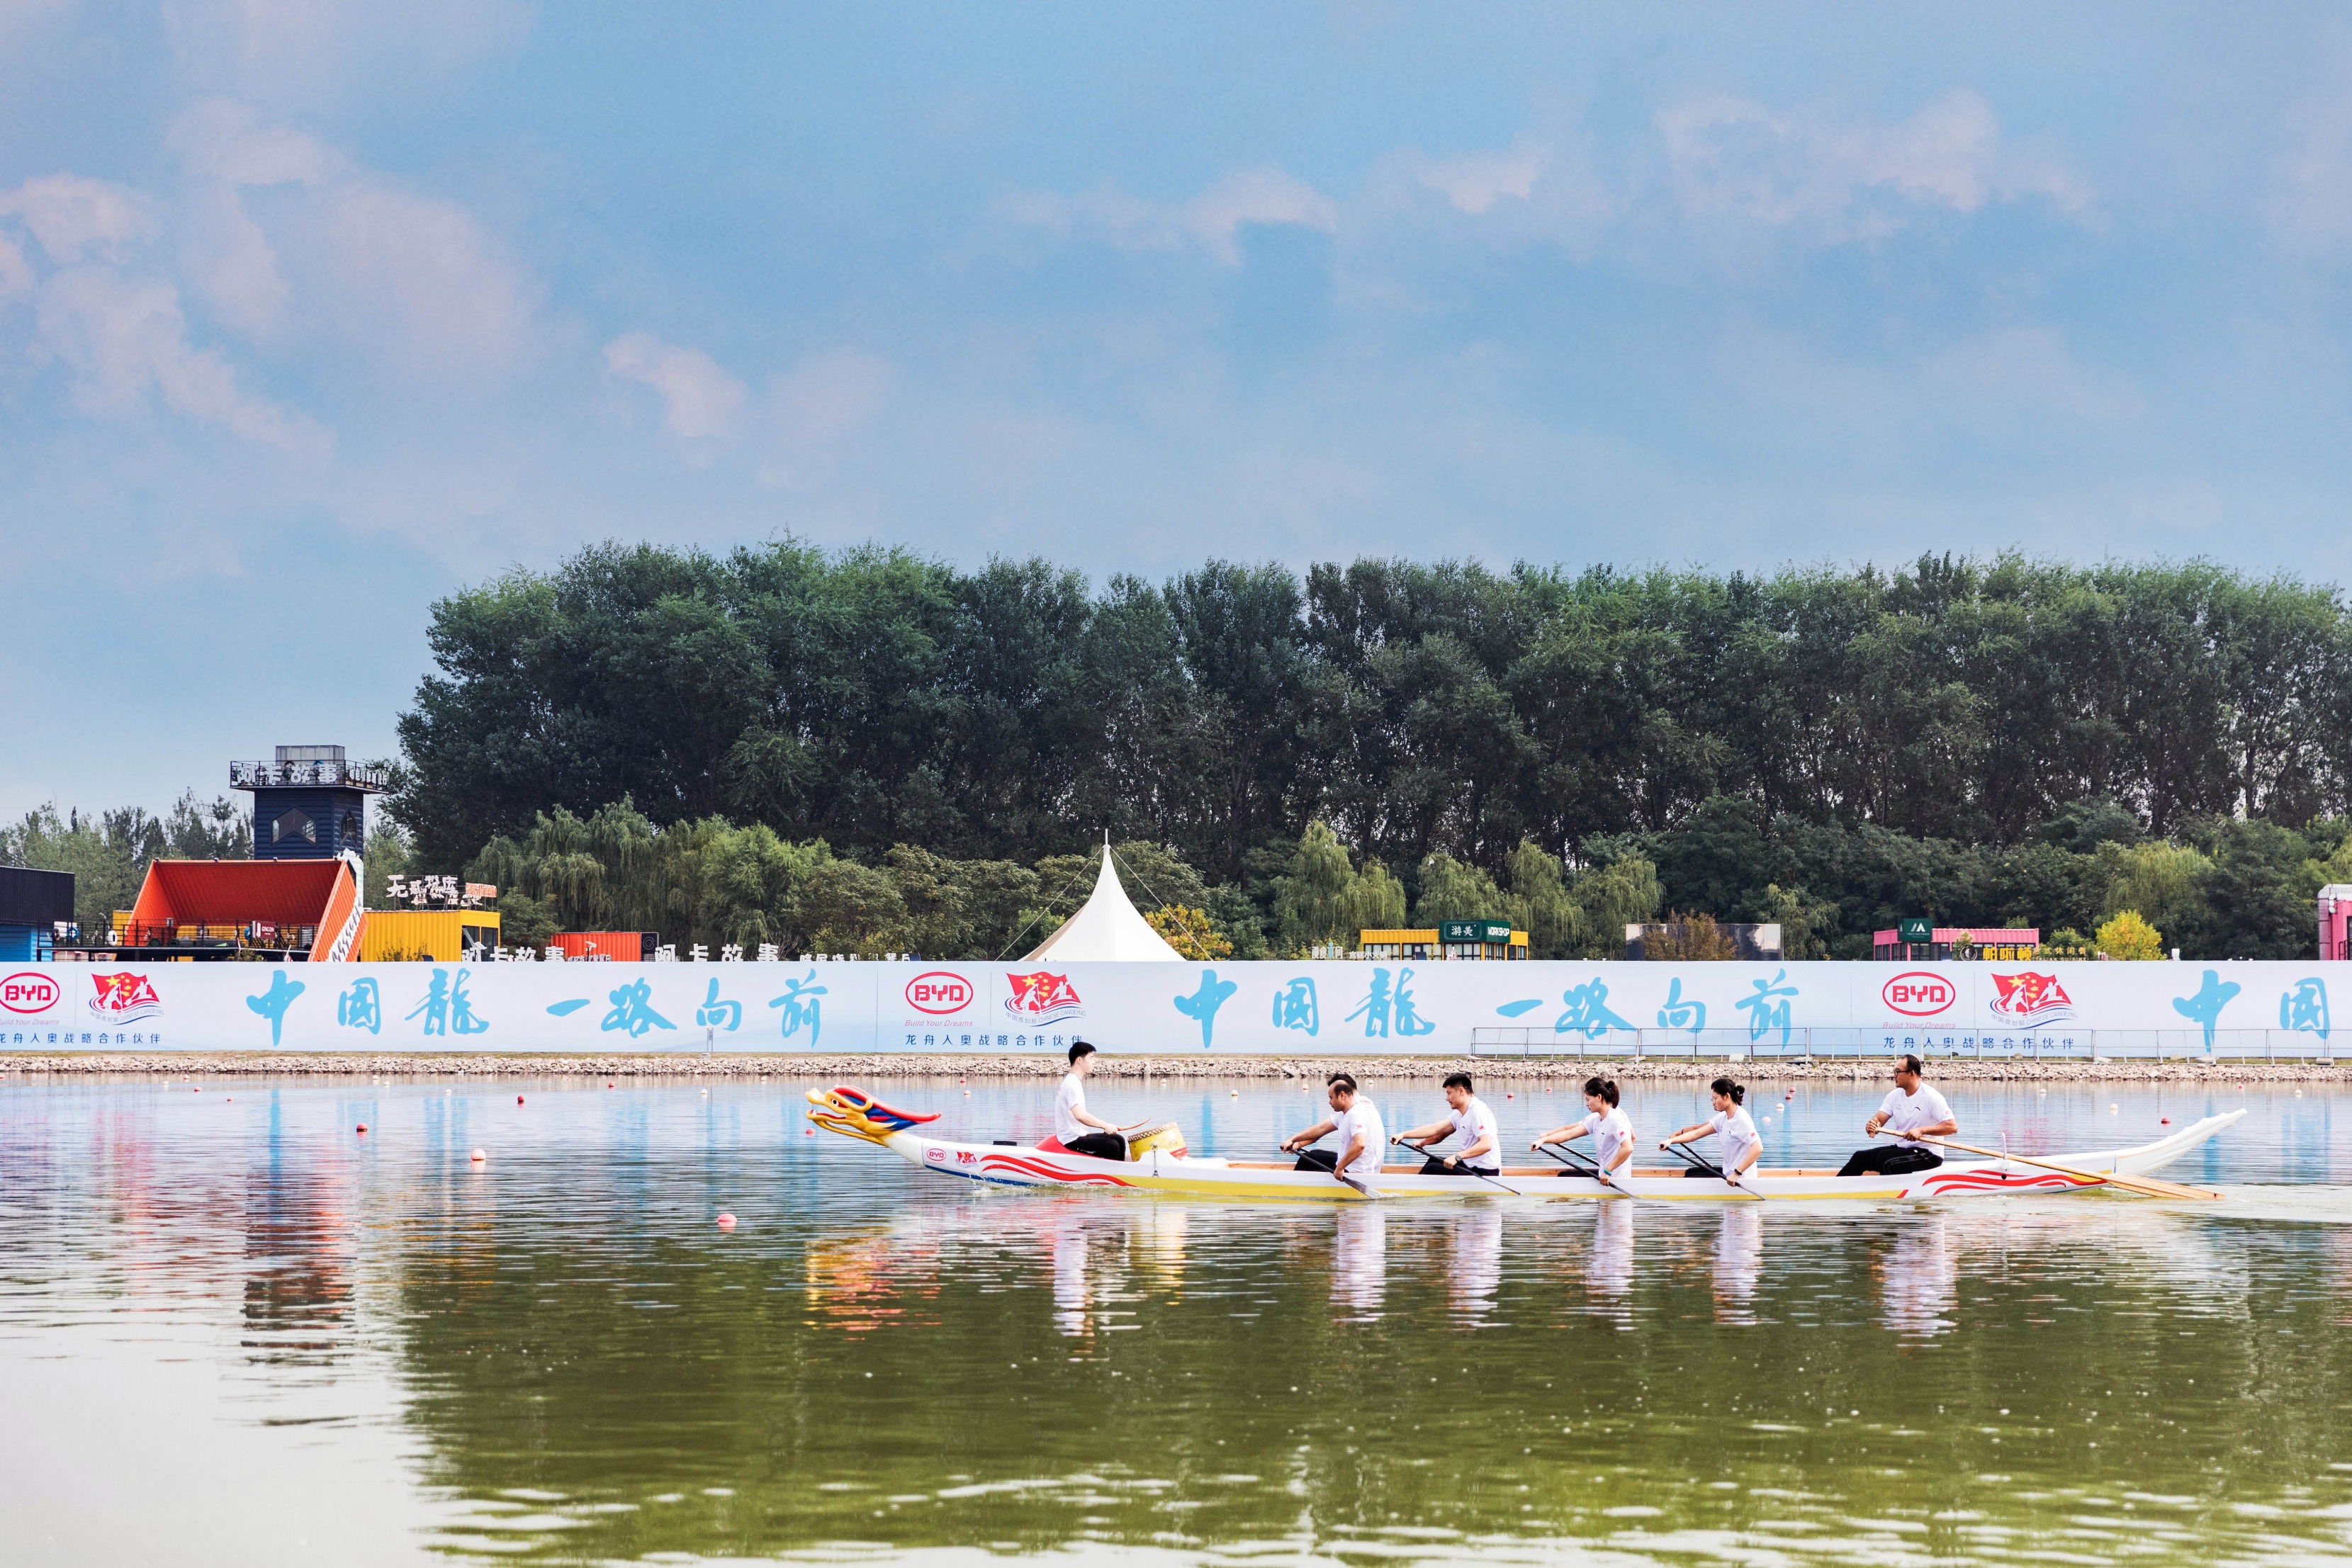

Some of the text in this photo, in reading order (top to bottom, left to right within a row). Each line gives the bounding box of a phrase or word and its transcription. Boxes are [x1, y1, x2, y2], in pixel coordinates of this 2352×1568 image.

[1451, 925, 1473, 936] 游美
[1488, 926, 1510, 937] WORKSHOP
[6, 986, 51, 1000] BYD
[915, 985, 964, 1001] BYD
[1892, 986, 1945, 1002] BYD
[120, 1010, 140, 1022] CHINESE
[1038, 1012, 1059, 1023] CHINESE
[2026, 1010, 2078, 1025] CHINESE CANOEING
